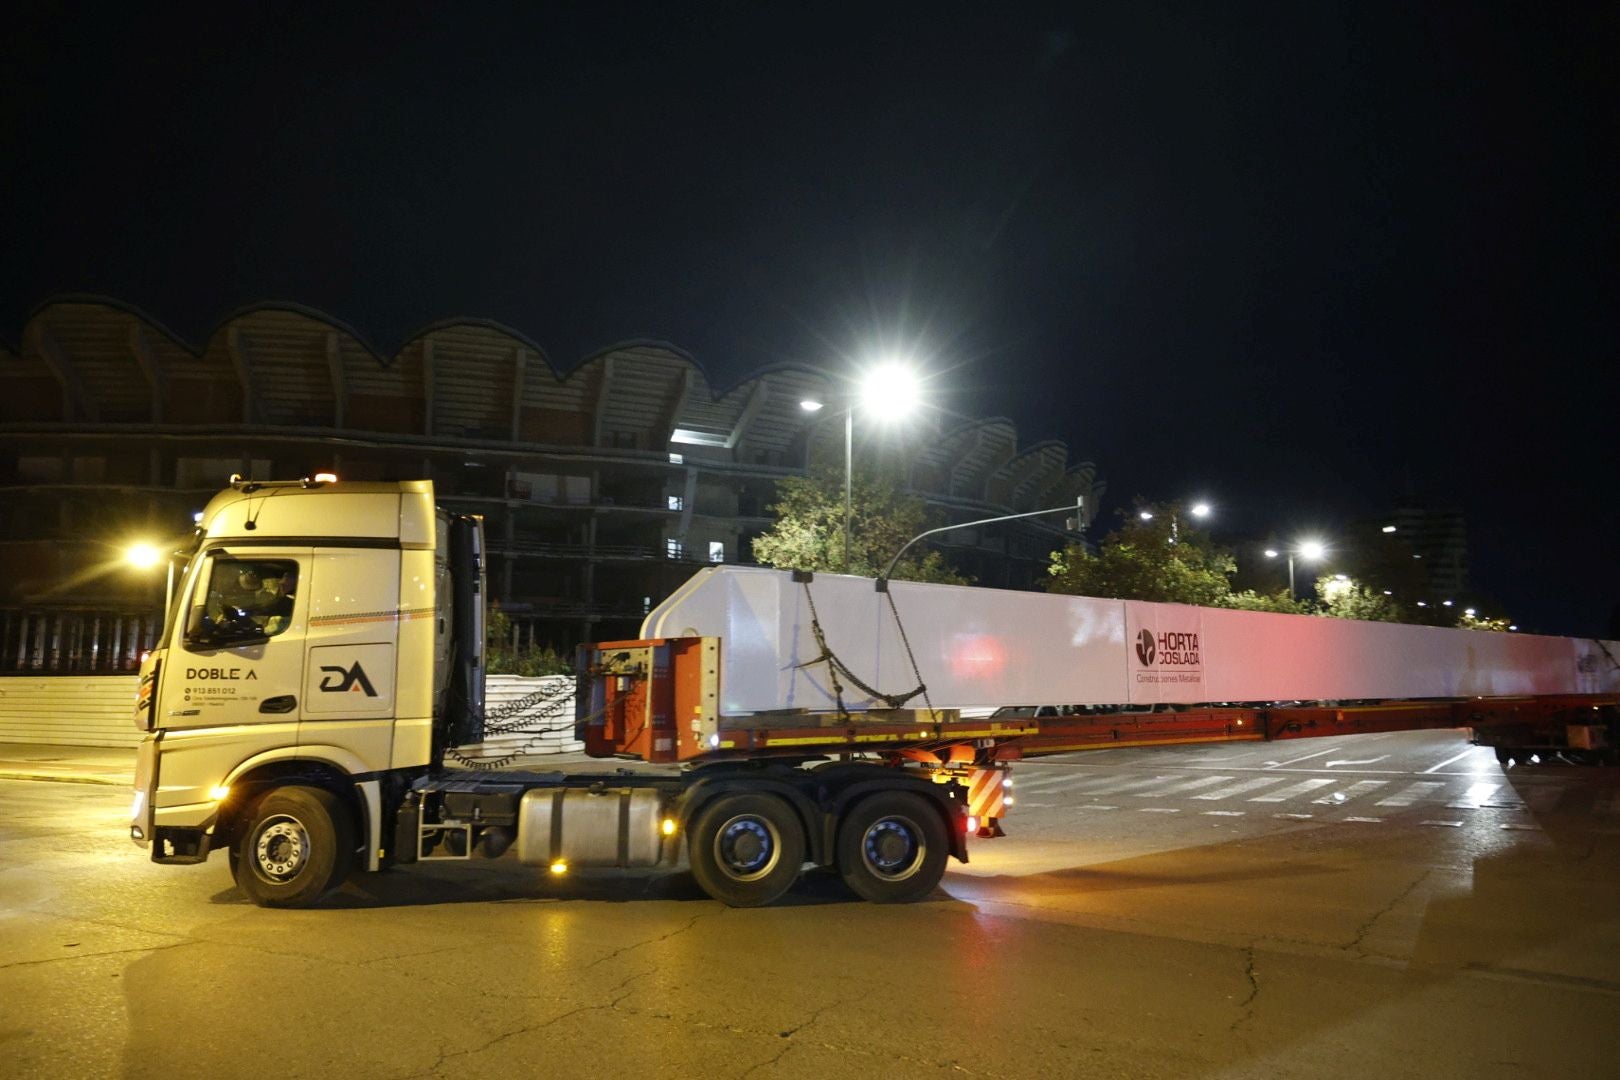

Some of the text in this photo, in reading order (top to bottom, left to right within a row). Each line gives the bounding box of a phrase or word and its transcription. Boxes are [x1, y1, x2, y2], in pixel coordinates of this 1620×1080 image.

[1157, 632, 1199, 651] HORTA
[1158, 651, 1200, 665] COSLADA
[186, 668, 241, 680] DOBLE
[207, 687, 221, 695] 851
[222, 687, 236, 695] 012
